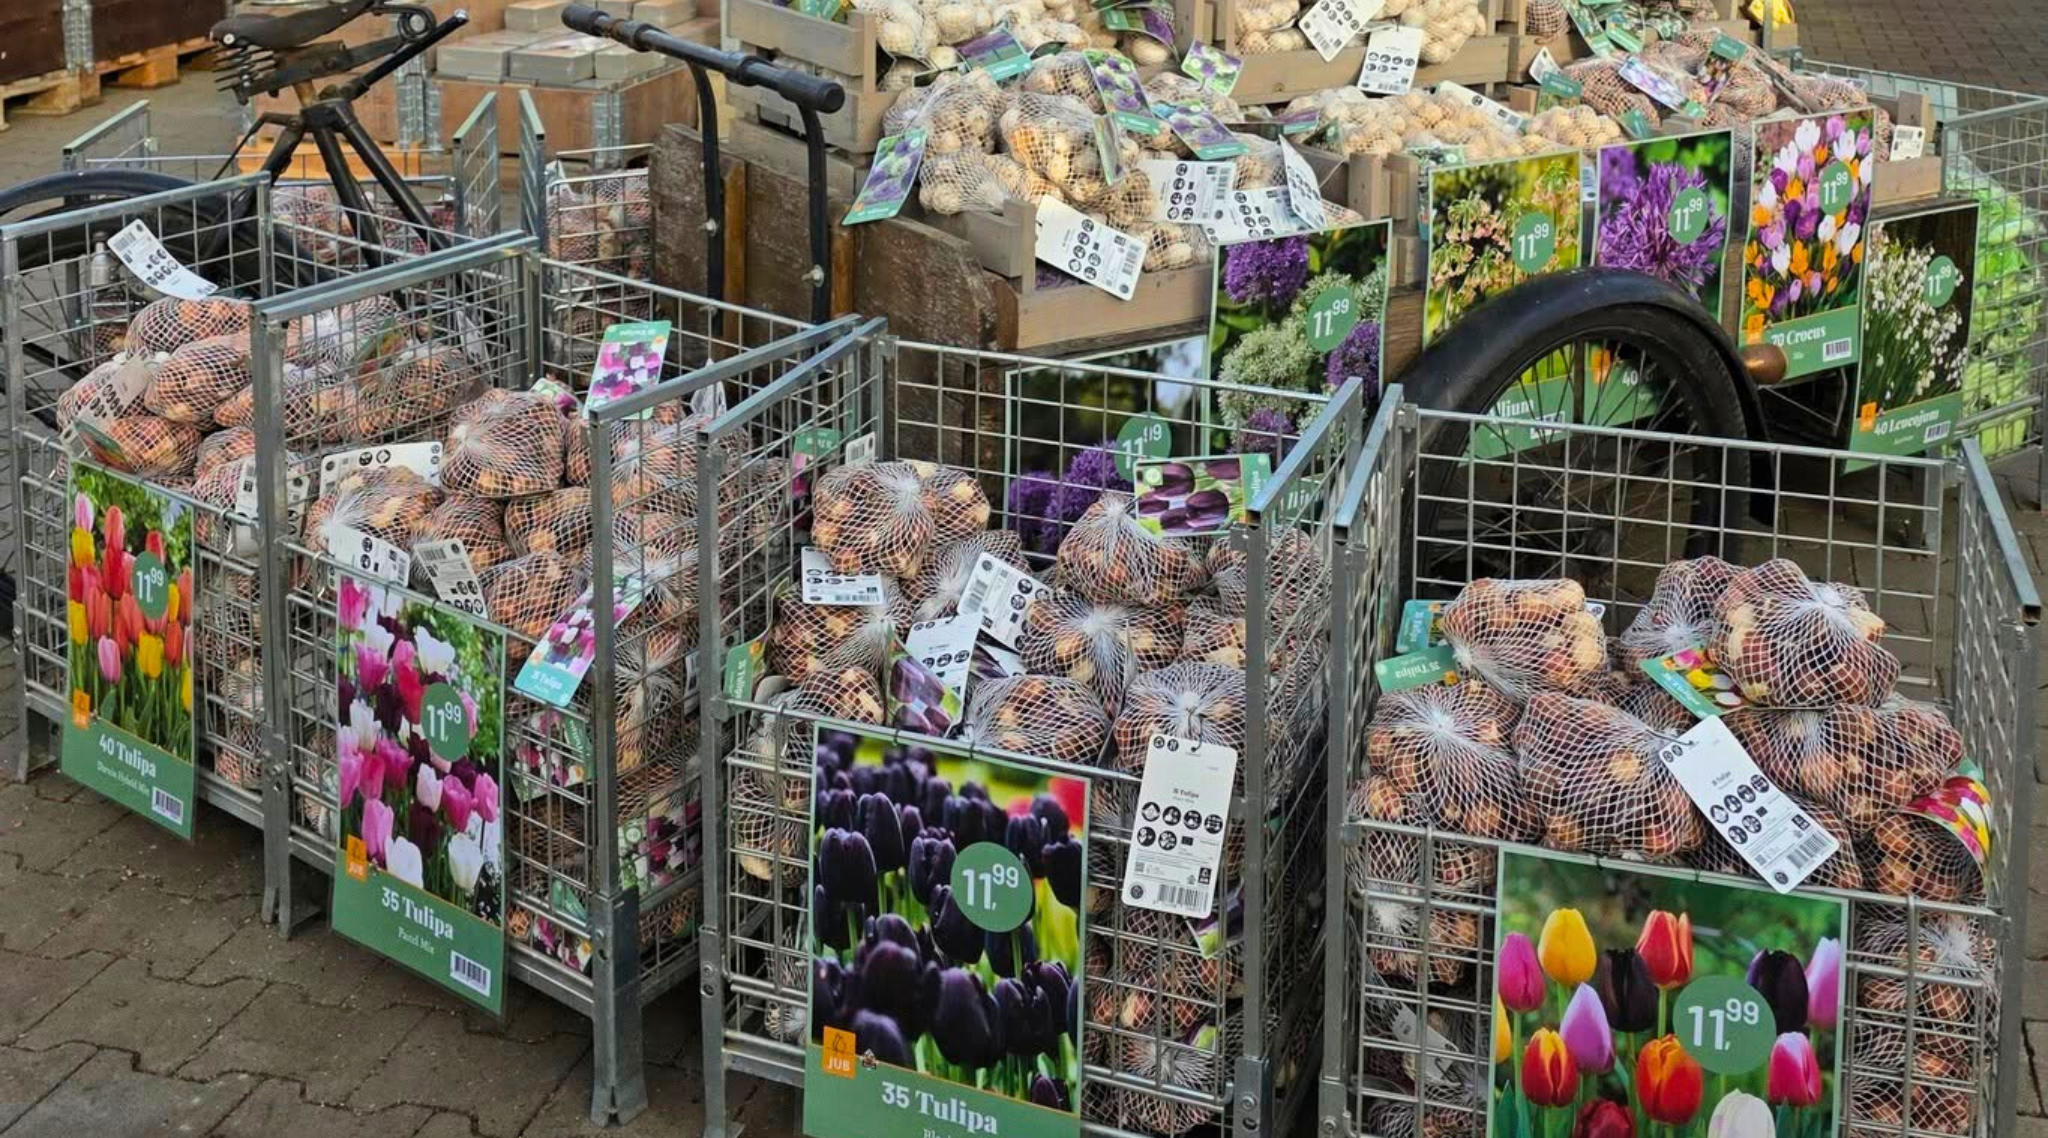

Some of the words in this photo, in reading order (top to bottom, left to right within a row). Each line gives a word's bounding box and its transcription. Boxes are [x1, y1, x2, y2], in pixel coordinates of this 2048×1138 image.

[1786, 325, 1827, 345] Crocus
[1622, 370, 1639, 386] 40
[1873, 421, 1888, 437] 40
[1888, 407, 1940, 434] Leucojum
[1395, 663, 1428, 678] Tulipa
[98, 733, 116, 756] 40
[116, 741, 158, 779] Tulipa
[380, 886, 400, 913] 35
[401, 895, 455, 941] Tulipa
[827, 1056, 851, 1072] JUB
[881, 1080, 910, 1110] 35
[914, 1090, 998, 1135] Tulipa
